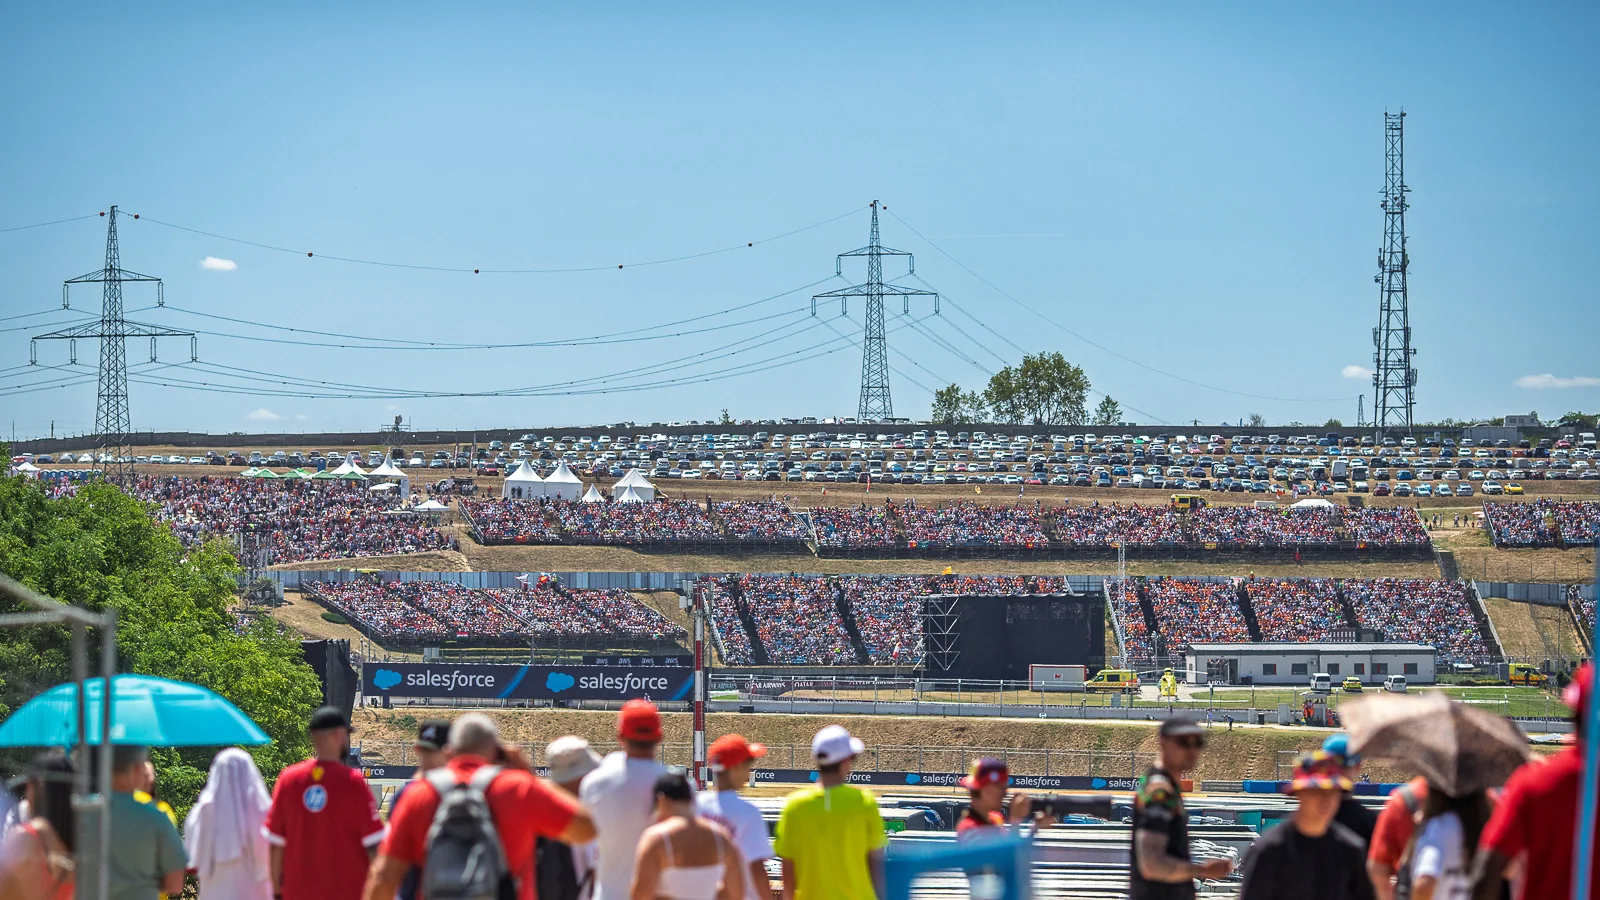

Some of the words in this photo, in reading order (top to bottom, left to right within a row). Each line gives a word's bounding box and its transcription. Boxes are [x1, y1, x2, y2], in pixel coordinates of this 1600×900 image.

[618, 657, 631, 665] aws
[641, 657, 654, 665] aws
[665, 657, 679, 665] aws
[407, 669, 495, 691] salesforce
[579, 672, 668, 694] salesforce
[753, 769, 775, 779] force
[845, 772, 872, 783] sforce
[1015, 776, 1061, 788] salesforce
[1108, 778, 1141, 790] salesfo
